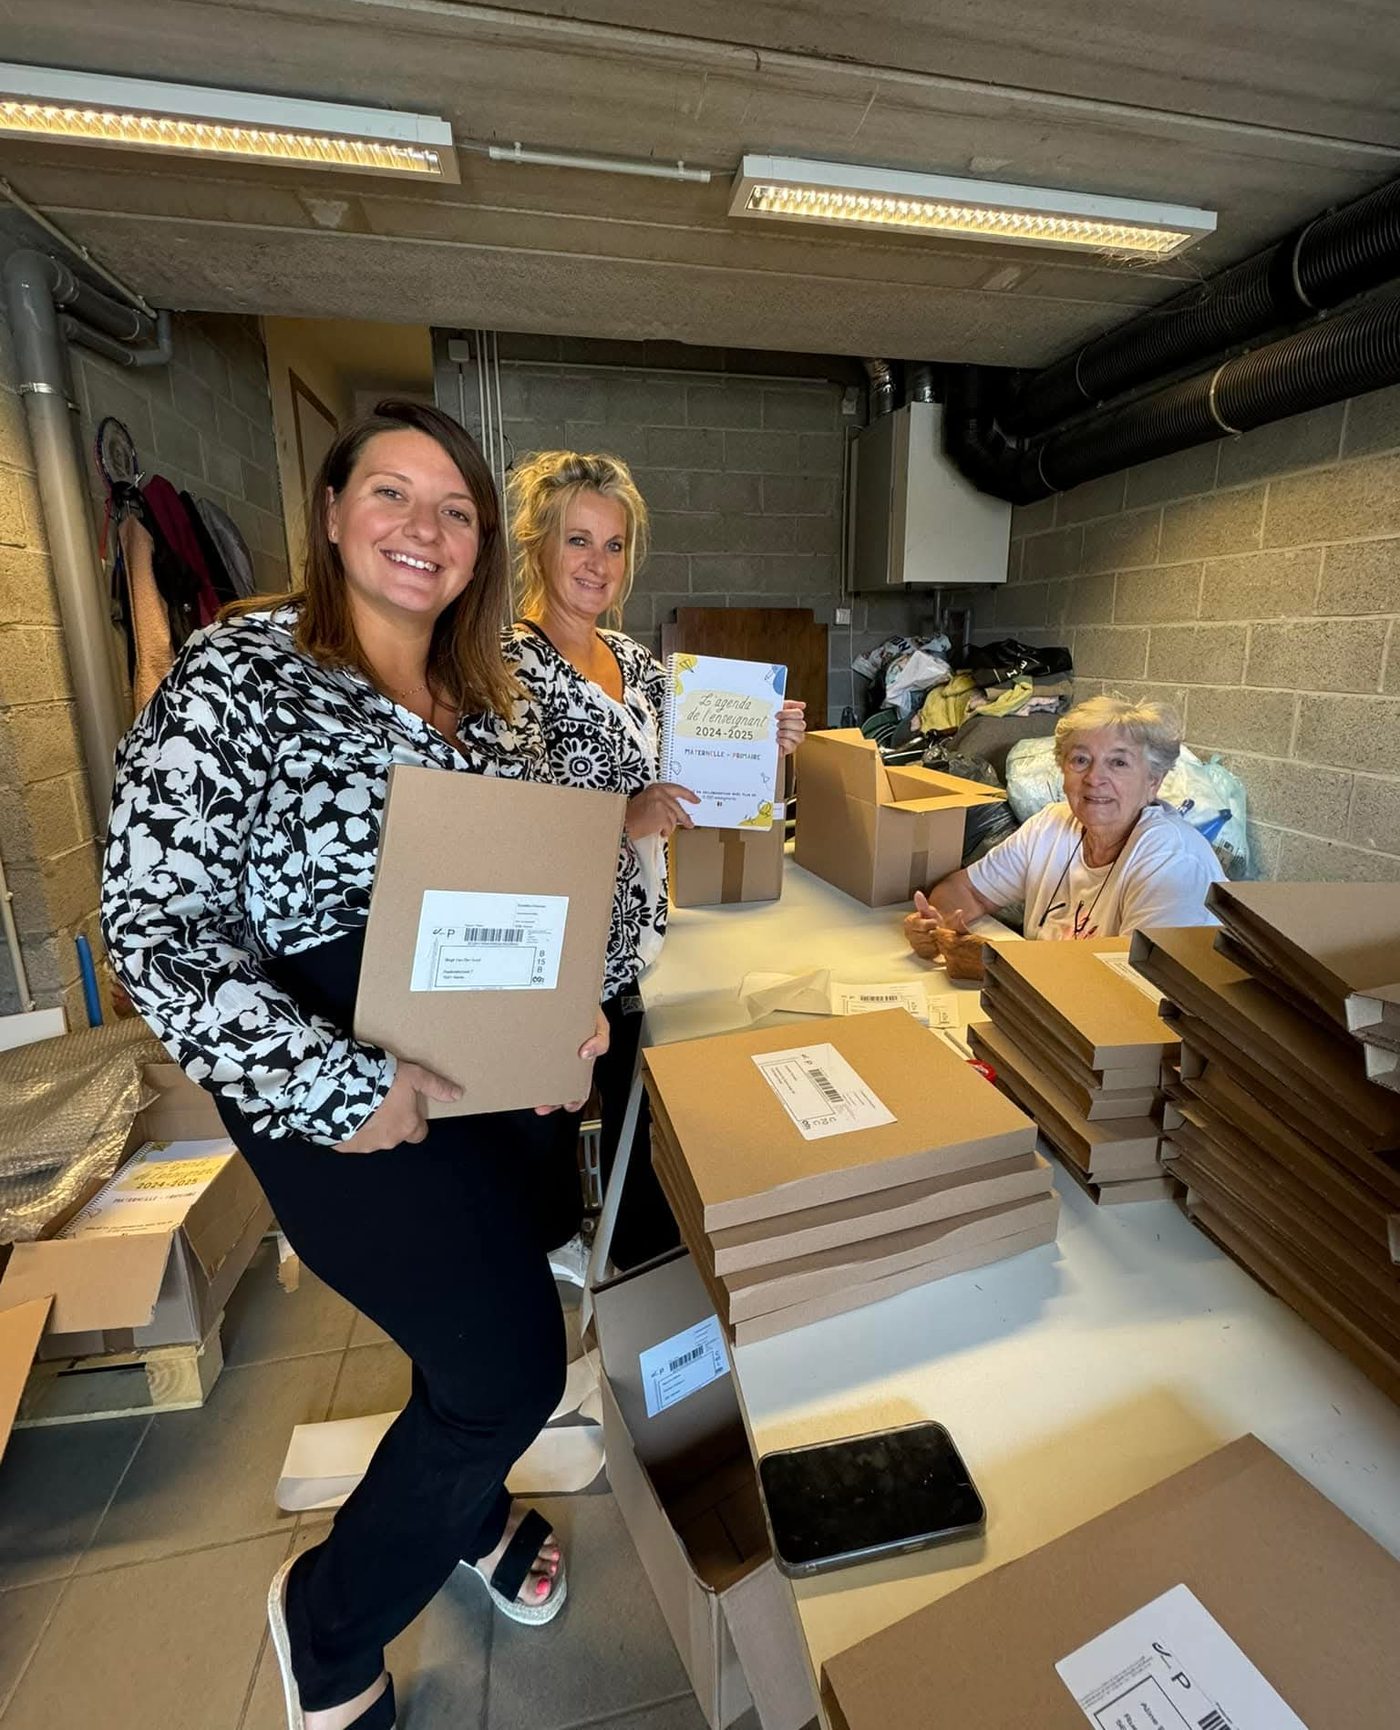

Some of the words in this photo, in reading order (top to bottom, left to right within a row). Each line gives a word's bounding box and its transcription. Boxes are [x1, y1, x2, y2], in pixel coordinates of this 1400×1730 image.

[699, 692, 752, 713] L'agenda
[686, 706, 701, 721] de
[702, 708, 768, 730] l'enseignant
[695, 726, 754, 740] 2024-2025
[1171, 1671, 1192, 1690] P
